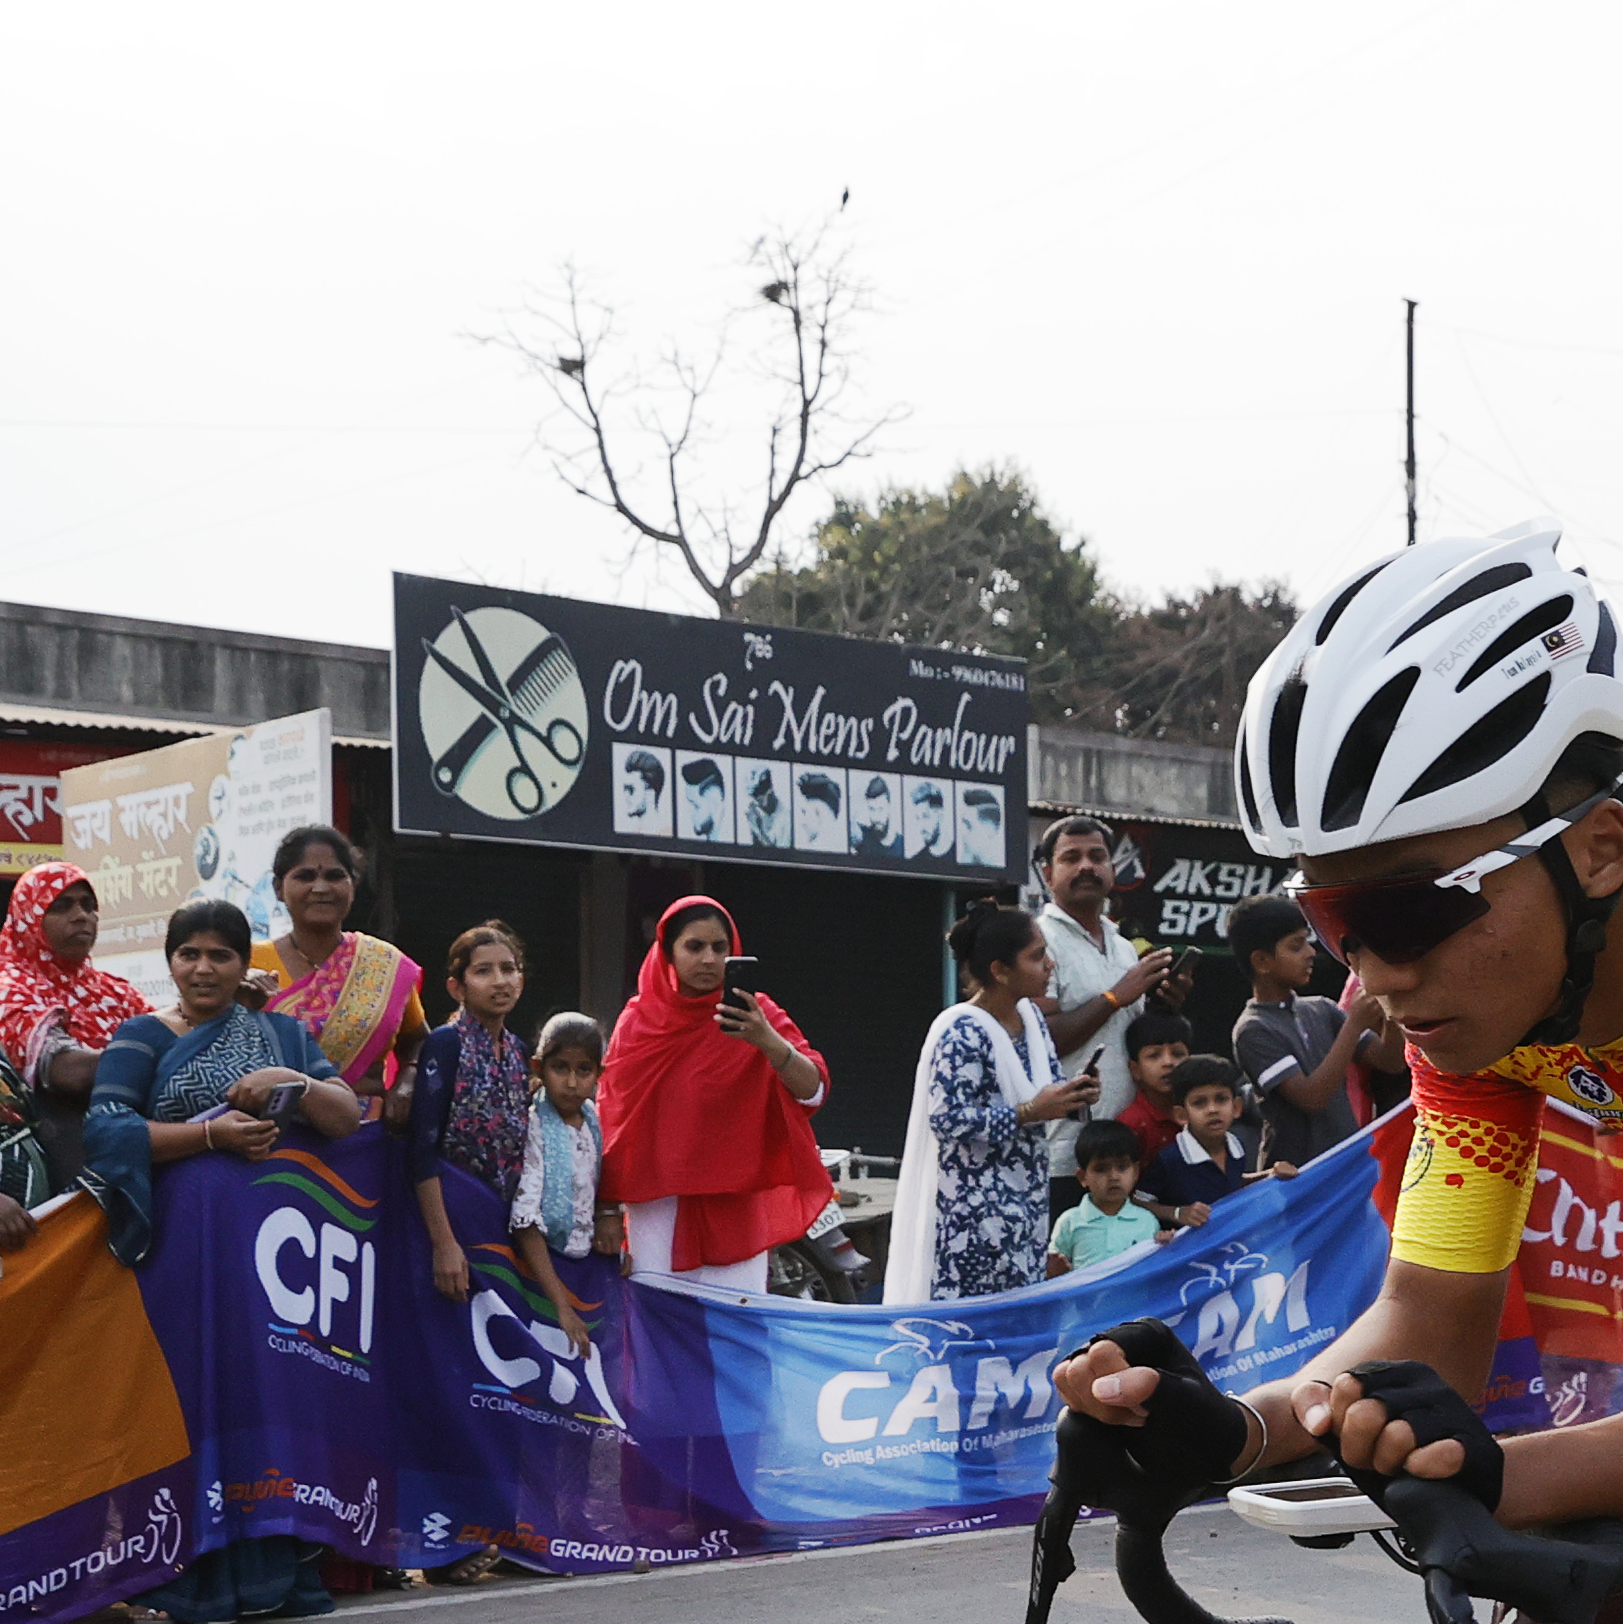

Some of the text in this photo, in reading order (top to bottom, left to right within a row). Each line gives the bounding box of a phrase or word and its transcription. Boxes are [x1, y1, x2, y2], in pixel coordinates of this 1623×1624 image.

[603, 658, 1015, 776] Om Sai Mens Parlour
[66, 800, 113, 850] जय
[115, 781, 195, 855] मल्हार
[254, 1206, 376, 1353] CFI
[1191, 1259, 1312, 1362] AM
[817, 1349, 1058, 1444] CAM
[1236, 1354, 1255, 1372] Of
[822, 1449, 875, 1469] Cycling
[876, 1438, 959, 1462] Association
[962, 1437, 979, 1452] Of
[69, 1534, 146, 1581] TOUR
[550, 1539, 635, 1563] GRAND
[636, 1546, 701, 1562] TOUR
